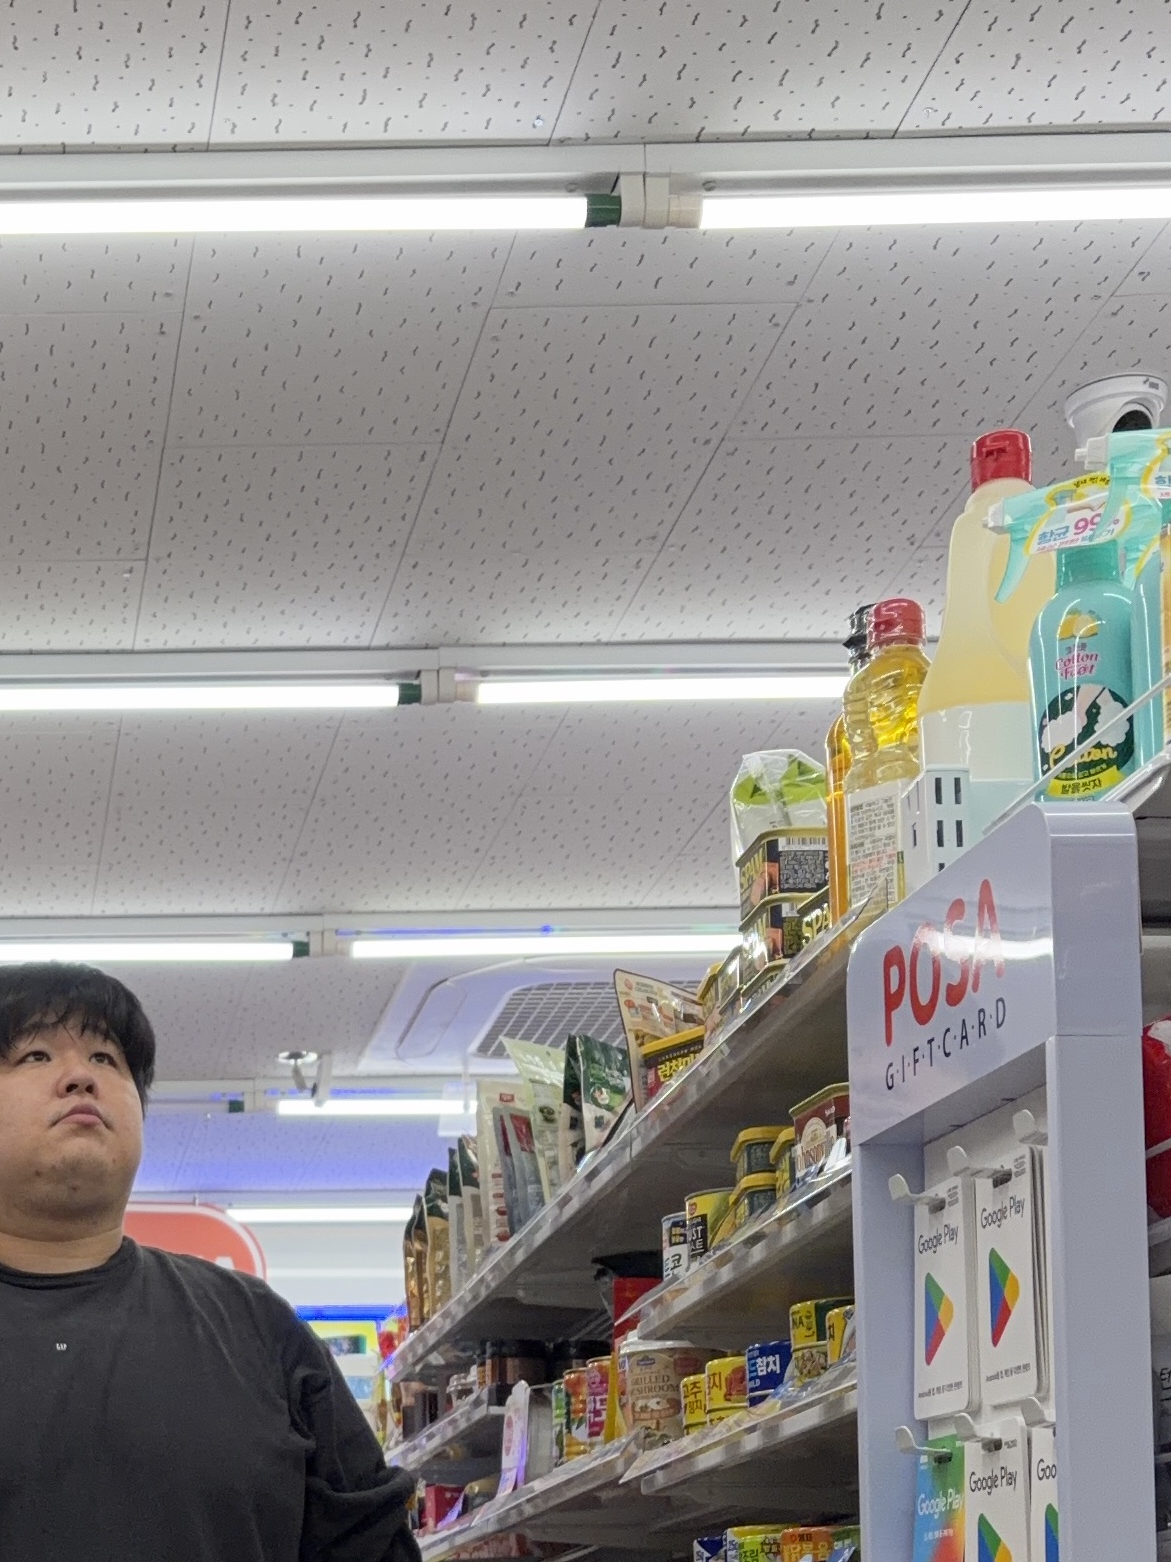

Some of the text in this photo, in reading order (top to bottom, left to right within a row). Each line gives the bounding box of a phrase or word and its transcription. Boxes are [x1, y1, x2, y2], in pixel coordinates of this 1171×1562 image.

[740, 845, 766, 889] SPAM
[882, 878, 1006, 1047] POSA
[980, 1194, 1026, 1229] Google Play
[917, 1223, 959, 1255] Google Play
[969, 1465, 1018, 1496] Google Play
[1036, 1458, 1057, 1482] Goo
[917, 1488, 948, 1520] Google
